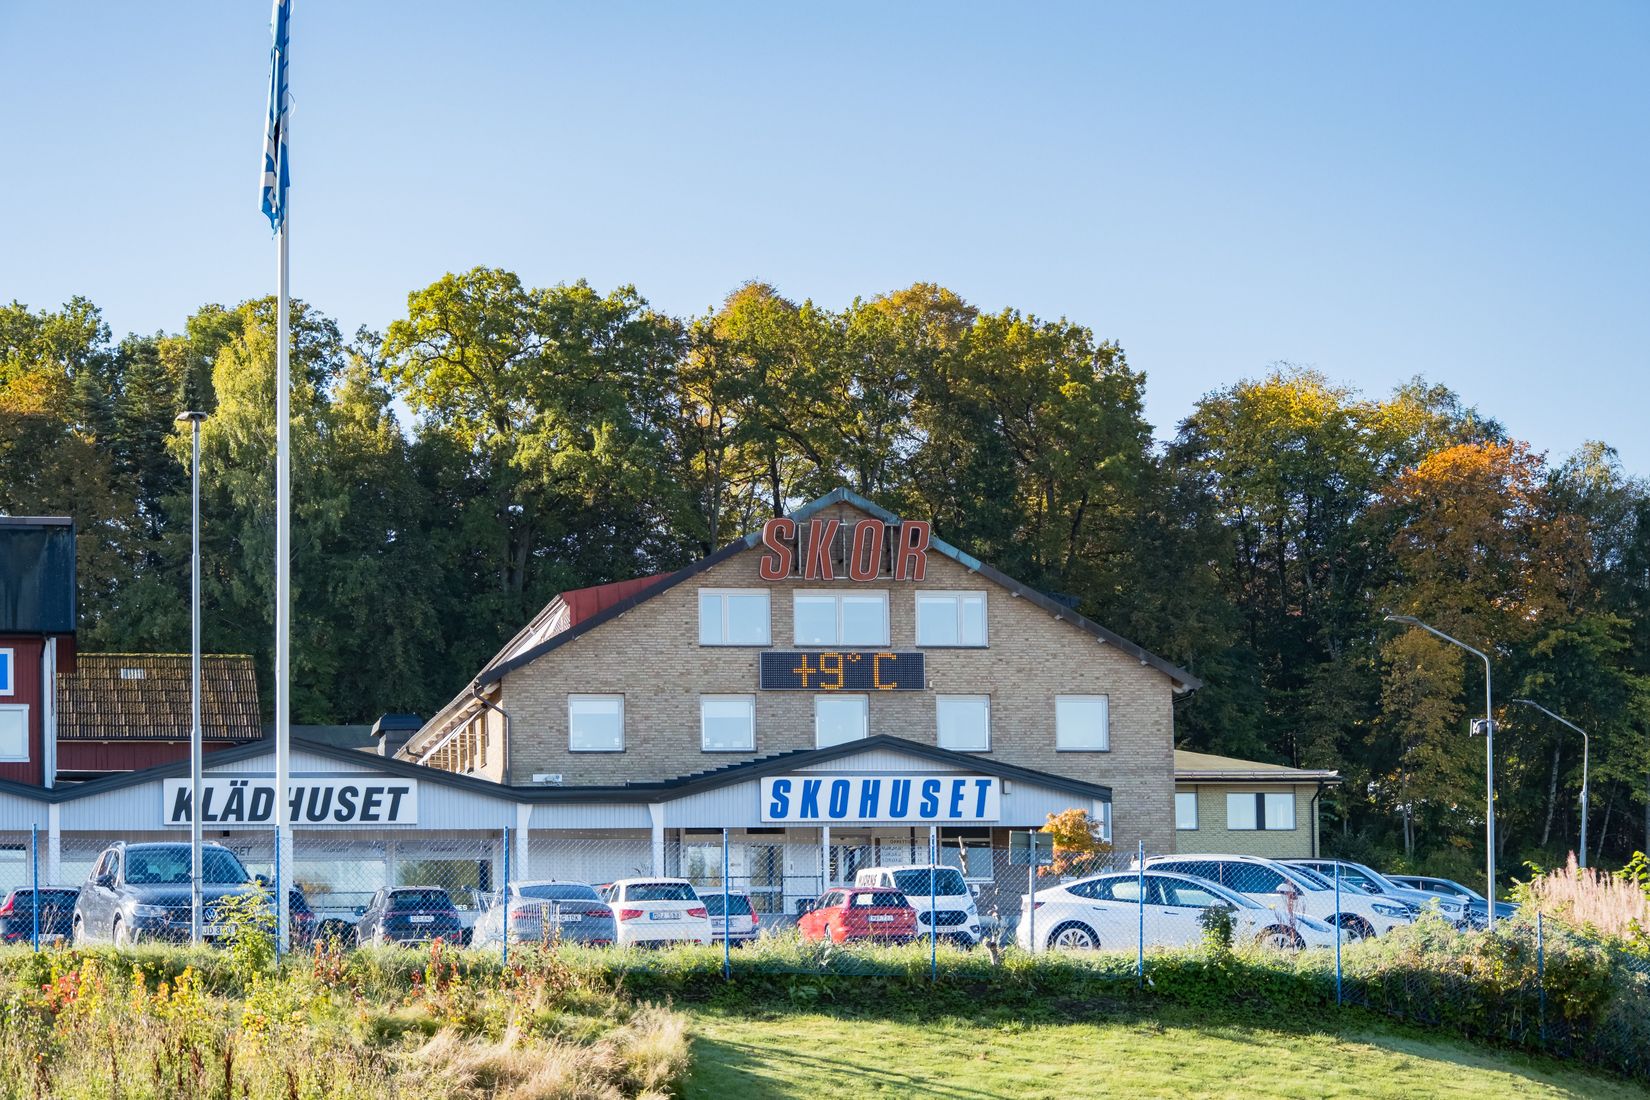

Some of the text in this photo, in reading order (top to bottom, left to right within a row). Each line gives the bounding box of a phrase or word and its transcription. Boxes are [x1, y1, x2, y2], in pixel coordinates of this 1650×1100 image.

[759, 518, 931, 582] SKOR
[171, 780, 410, 822] KLÄDHUSET
[770, 779, 992, 819] SKOHUSET
